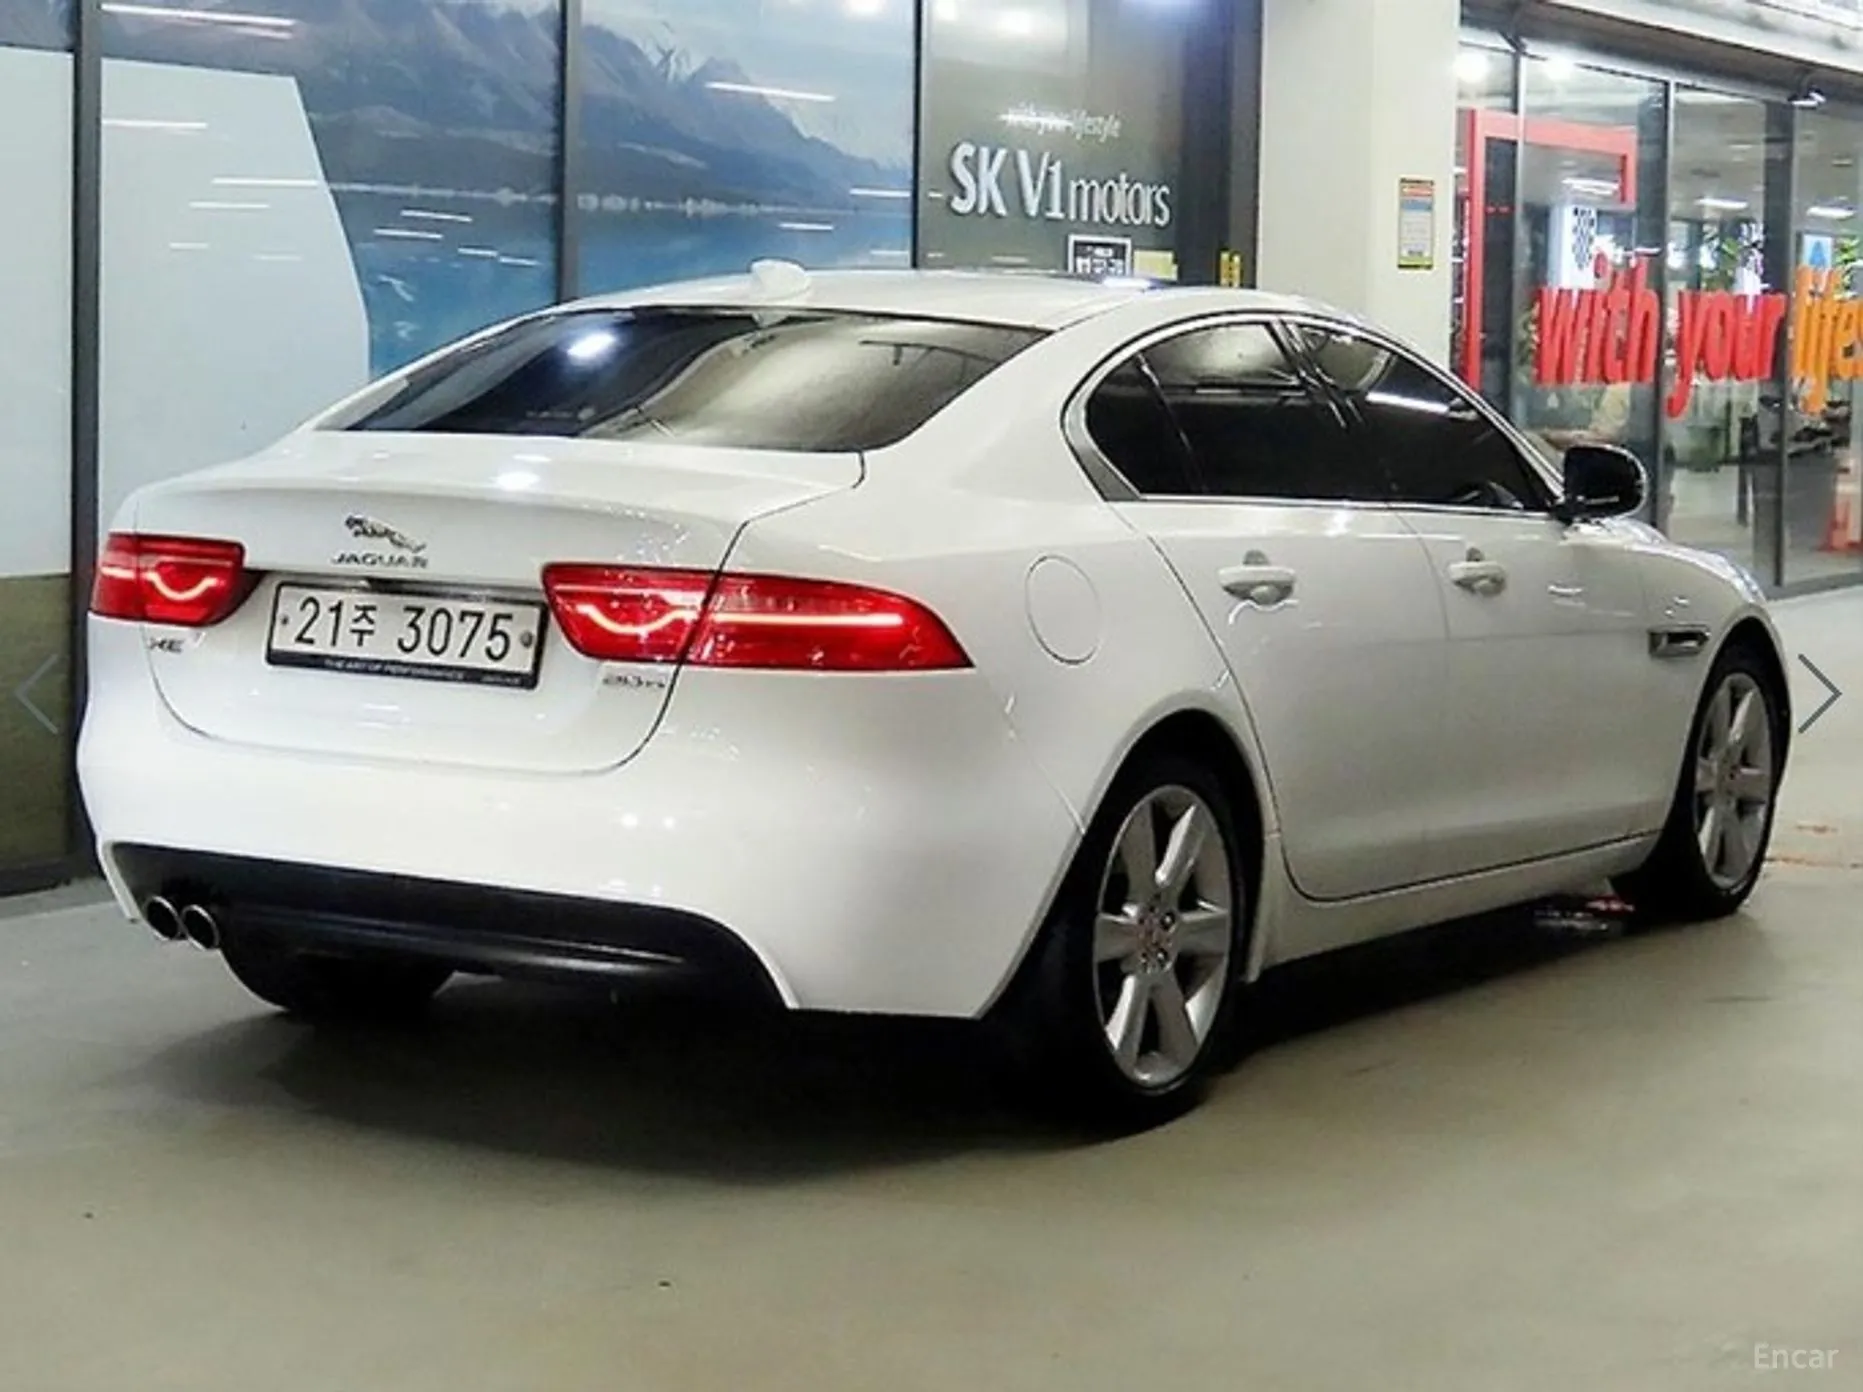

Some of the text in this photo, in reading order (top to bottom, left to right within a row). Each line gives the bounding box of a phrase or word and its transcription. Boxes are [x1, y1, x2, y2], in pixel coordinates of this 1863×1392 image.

[950, 141, 1171, 229] SK V1 motors
[1536, 246, 1661, 387] with
[1666, 289, 1789, 421] your
[330, 551, 429, 569] JAGUAR
[294, 596, 514, 662] 21주 3075
